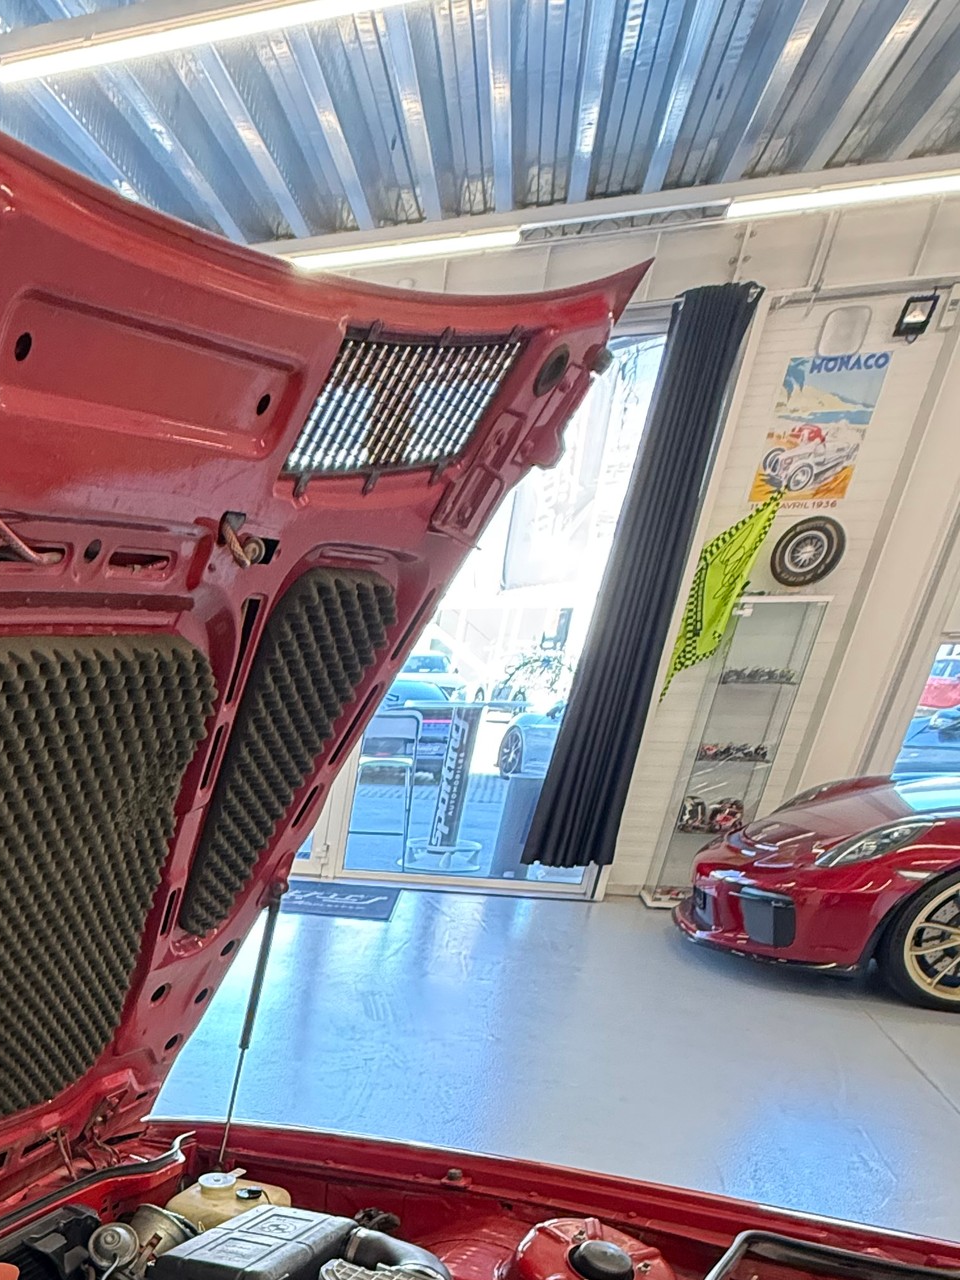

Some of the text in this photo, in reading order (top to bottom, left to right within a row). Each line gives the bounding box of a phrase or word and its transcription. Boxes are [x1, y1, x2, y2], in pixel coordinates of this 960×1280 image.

[809, 353, 890, 374] MONACO
[780, 500, 837, 510] AVRIL 1936
[448, 752, 465, 816] AUTOMOBILES
